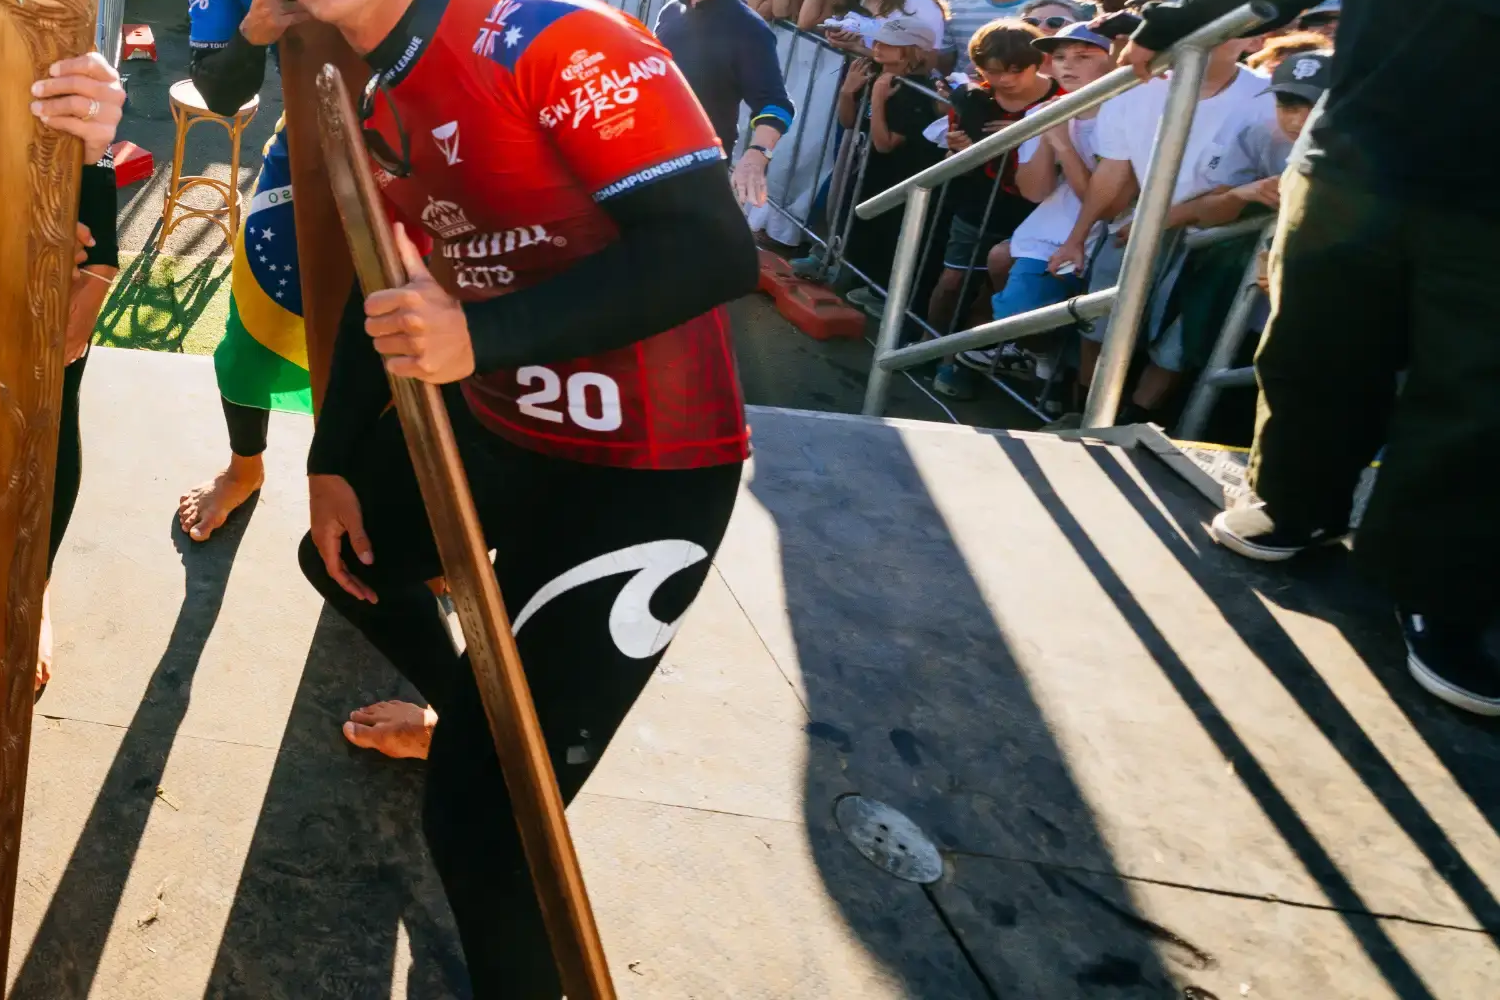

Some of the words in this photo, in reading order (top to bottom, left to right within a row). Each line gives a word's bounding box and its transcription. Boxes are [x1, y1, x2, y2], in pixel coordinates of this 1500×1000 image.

[394, 35, 423, 72] LEAGUE
[570, 56, 667, 110] ZEALAND
[572, 86, 639, 129] PRO
[593, 153, 694, 202] CHAMPIONSHIP
[516, 365, 623, 432] 20
